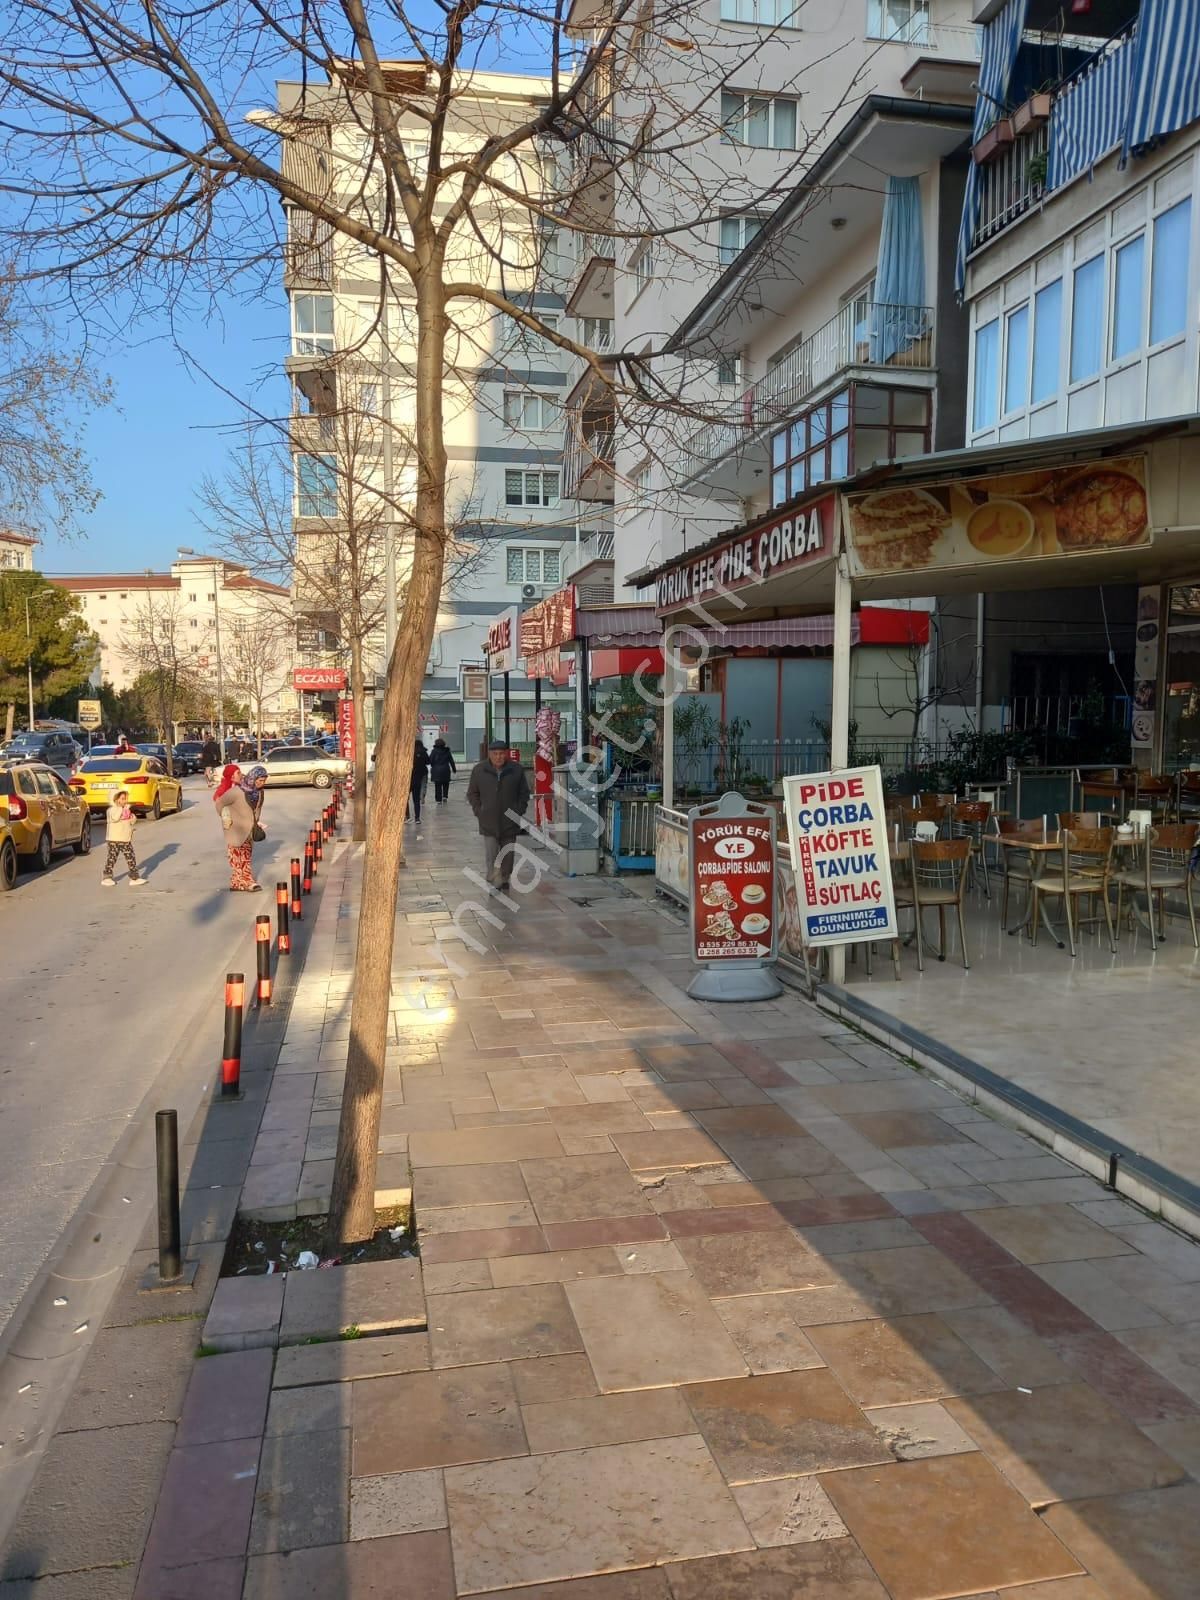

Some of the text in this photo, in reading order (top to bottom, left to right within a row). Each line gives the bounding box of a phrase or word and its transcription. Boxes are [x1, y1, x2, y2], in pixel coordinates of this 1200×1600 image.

[656, 565, 690, 608] YÖRÜK
[692, 555, 715, 596] EFE
[758, 507, 822, 578] ÇORBA
[295, 674, 341, 684] ECZANE
[343, 703, 352, 758] ECZANE
[798, 802, 873, 833] ÇORBA
[697, 824, 771, 843] YÖRÜK EFE
[813, 829, 873, 853] KÖFTE
[725, 843, 745, 854] Y.E
[743, 861, 771, 875] SALONU
[815, 853, 878, 879] TAVUK
[819, 880, 882, 906] SÜTLAÇ
[810, 918, 886, 934] ODUNLUDUR
[818, 909, 877, 925] FIRINIMIZ
